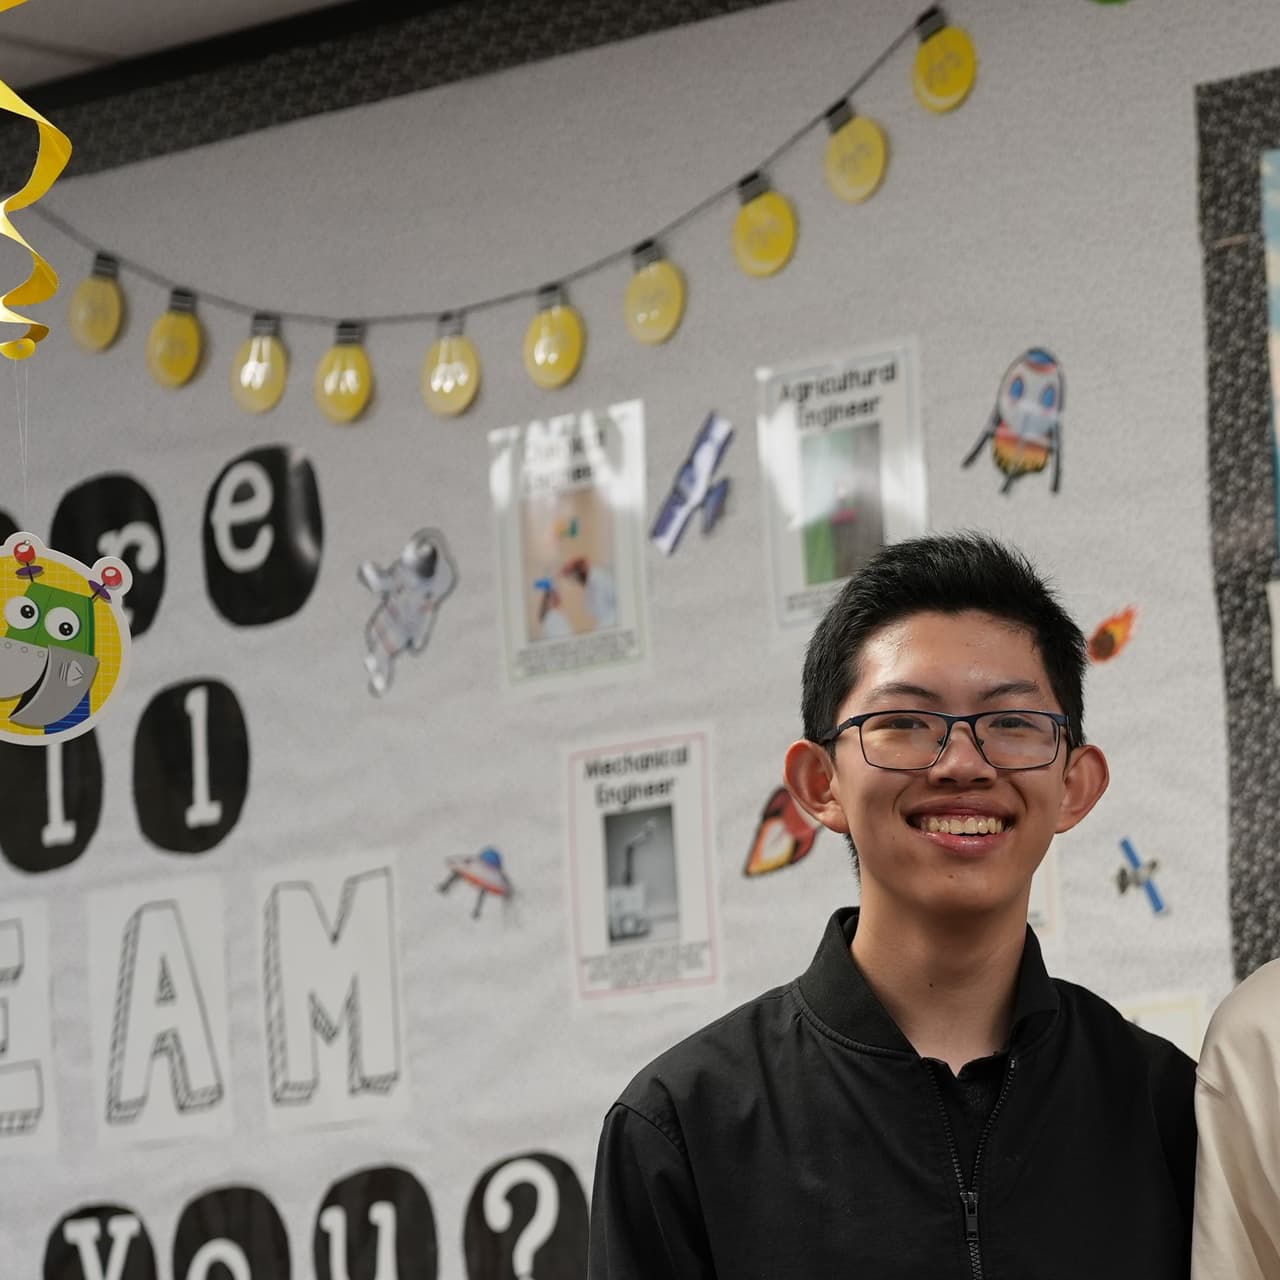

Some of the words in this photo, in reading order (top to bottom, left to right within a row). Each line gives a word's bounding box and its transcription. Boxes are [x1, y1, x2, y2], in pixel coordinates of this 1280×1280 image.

[780, 360, 897, 409] Agricultural
[798, 395, 881, 433] Engineer
[585, 744, 689, 779] Mechanical
[595, 777, 674, 811] Engineer
